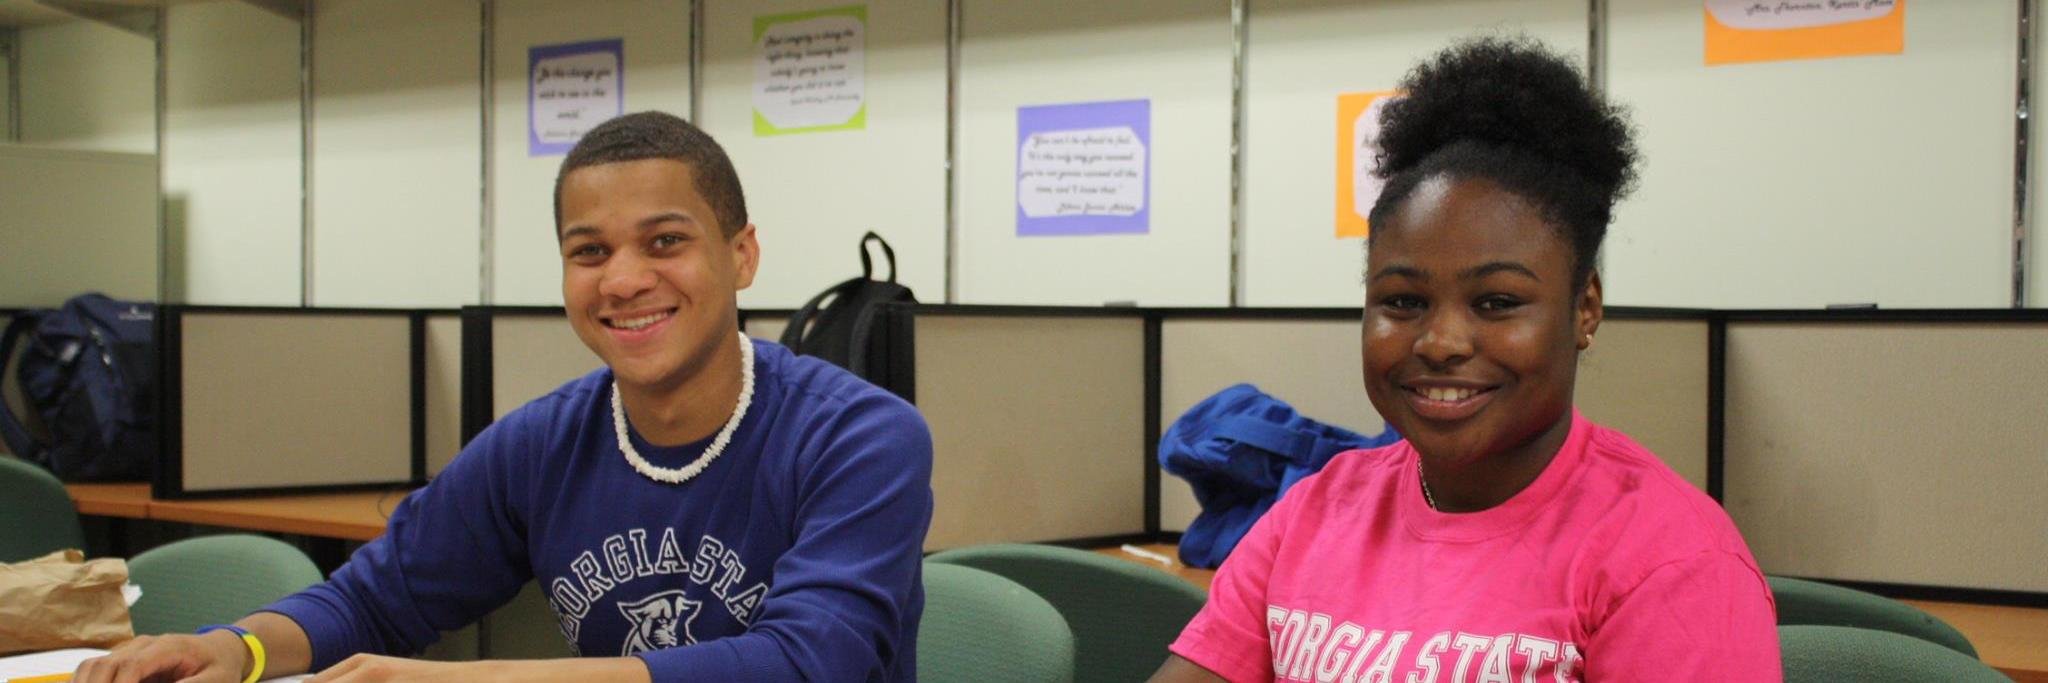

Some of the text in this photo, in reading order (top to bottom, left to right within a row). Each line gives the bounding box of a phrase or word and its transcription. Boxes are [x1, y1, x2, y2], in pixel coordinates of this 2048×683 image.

[552, 527, 770, 656] EORGIA STA
[1266, 604, 1412, 683] EORGIA
